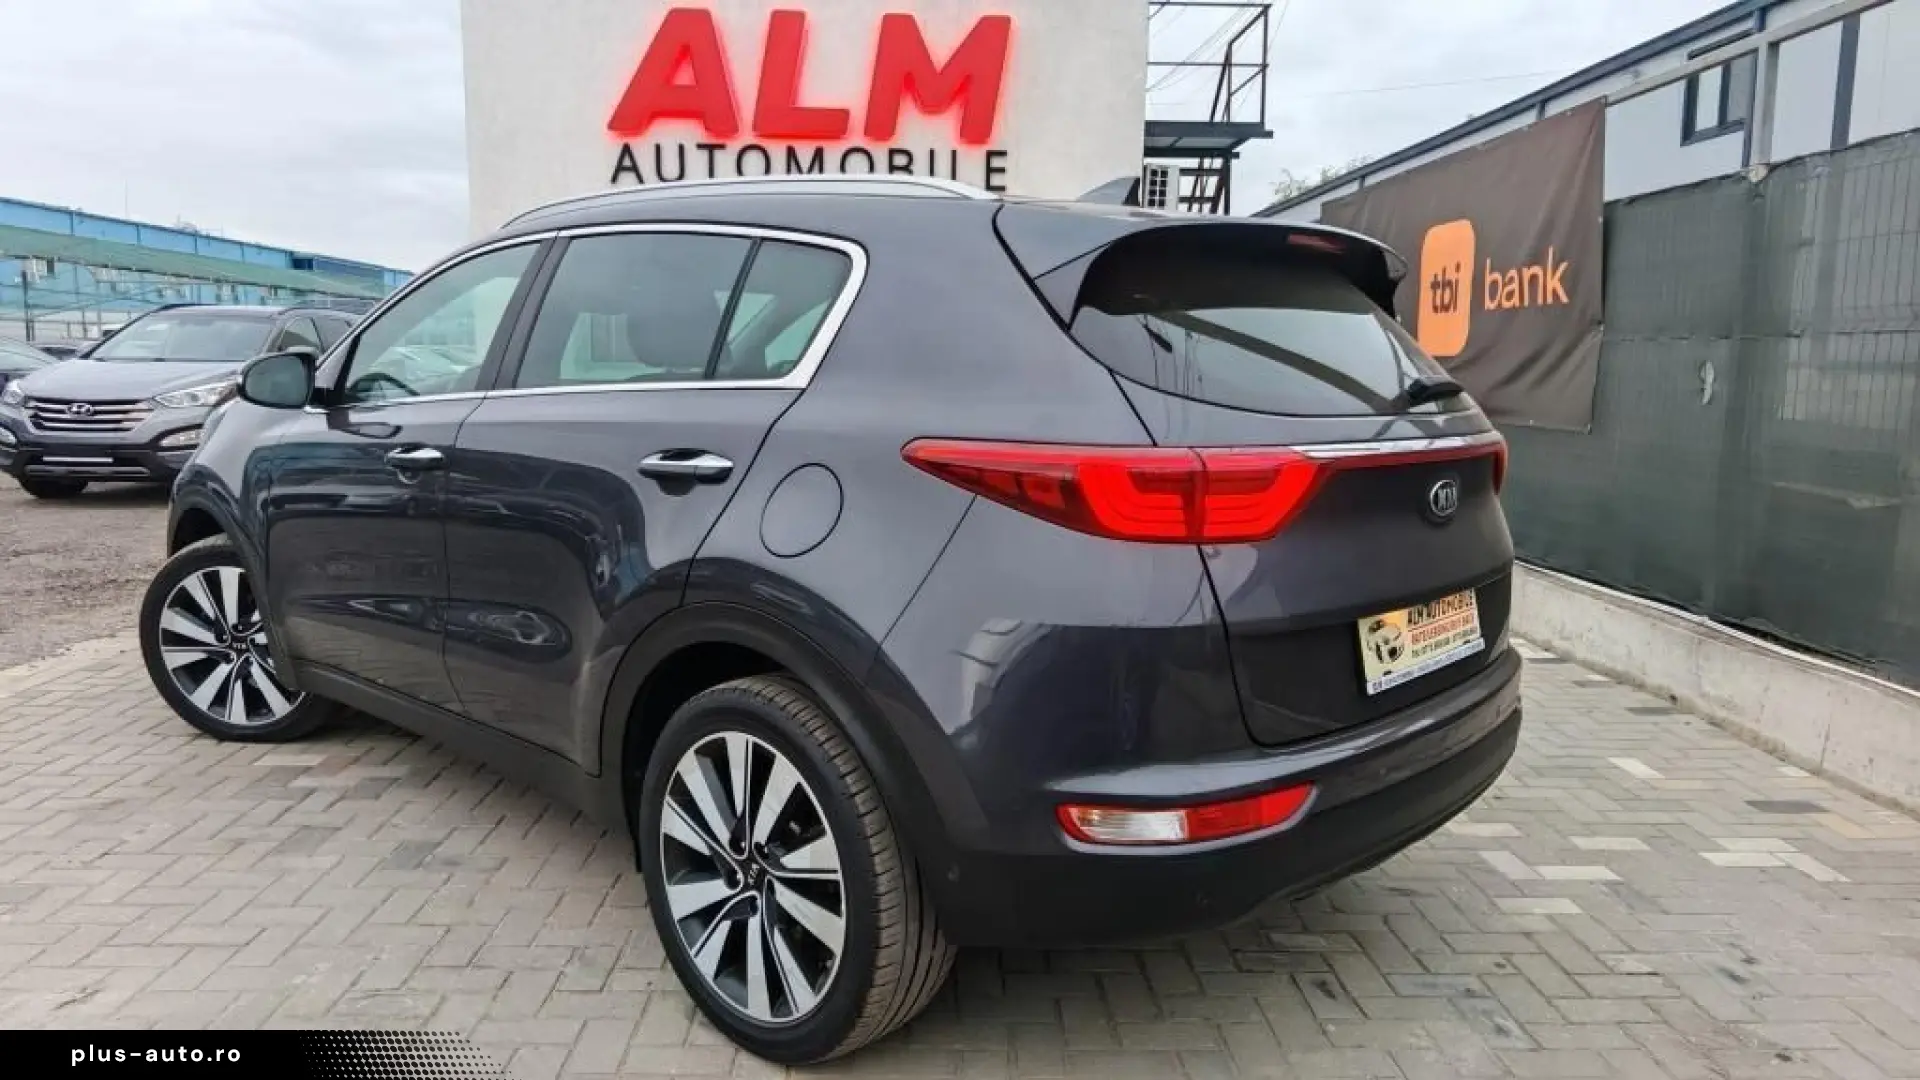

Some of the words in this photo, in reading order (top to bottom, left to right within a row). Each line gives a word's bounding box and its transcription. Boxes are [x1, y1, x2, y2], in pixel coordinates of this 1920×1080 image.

[607, 7, 1012, 144] ALM
[1430, 261, 1462, 314] tbi
[1484, 245, 1570, 311] bank
